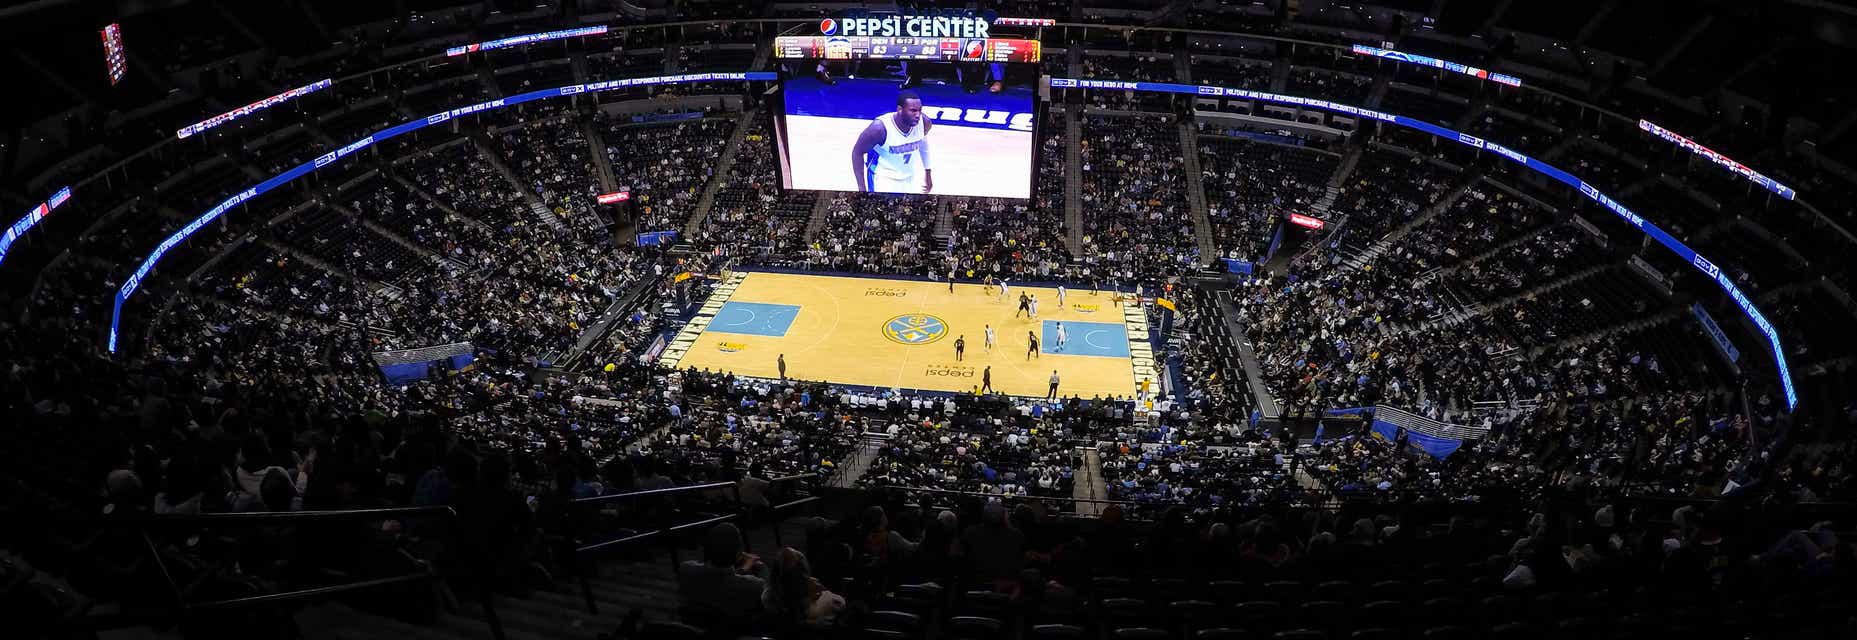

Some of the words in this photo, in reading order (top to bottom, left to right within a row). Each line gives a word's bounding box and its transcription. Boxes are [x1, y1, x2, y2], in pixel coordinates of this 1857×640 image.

[842, 18, 900, 37] PEPSI
[906, 19, 989, 38] CENTER
[873, 45, 888, 54] 63
[903, 153, 912, 164] 7
[865, 290, 906, 298] pepsi
[925, 368, 975, 378] pepsi
